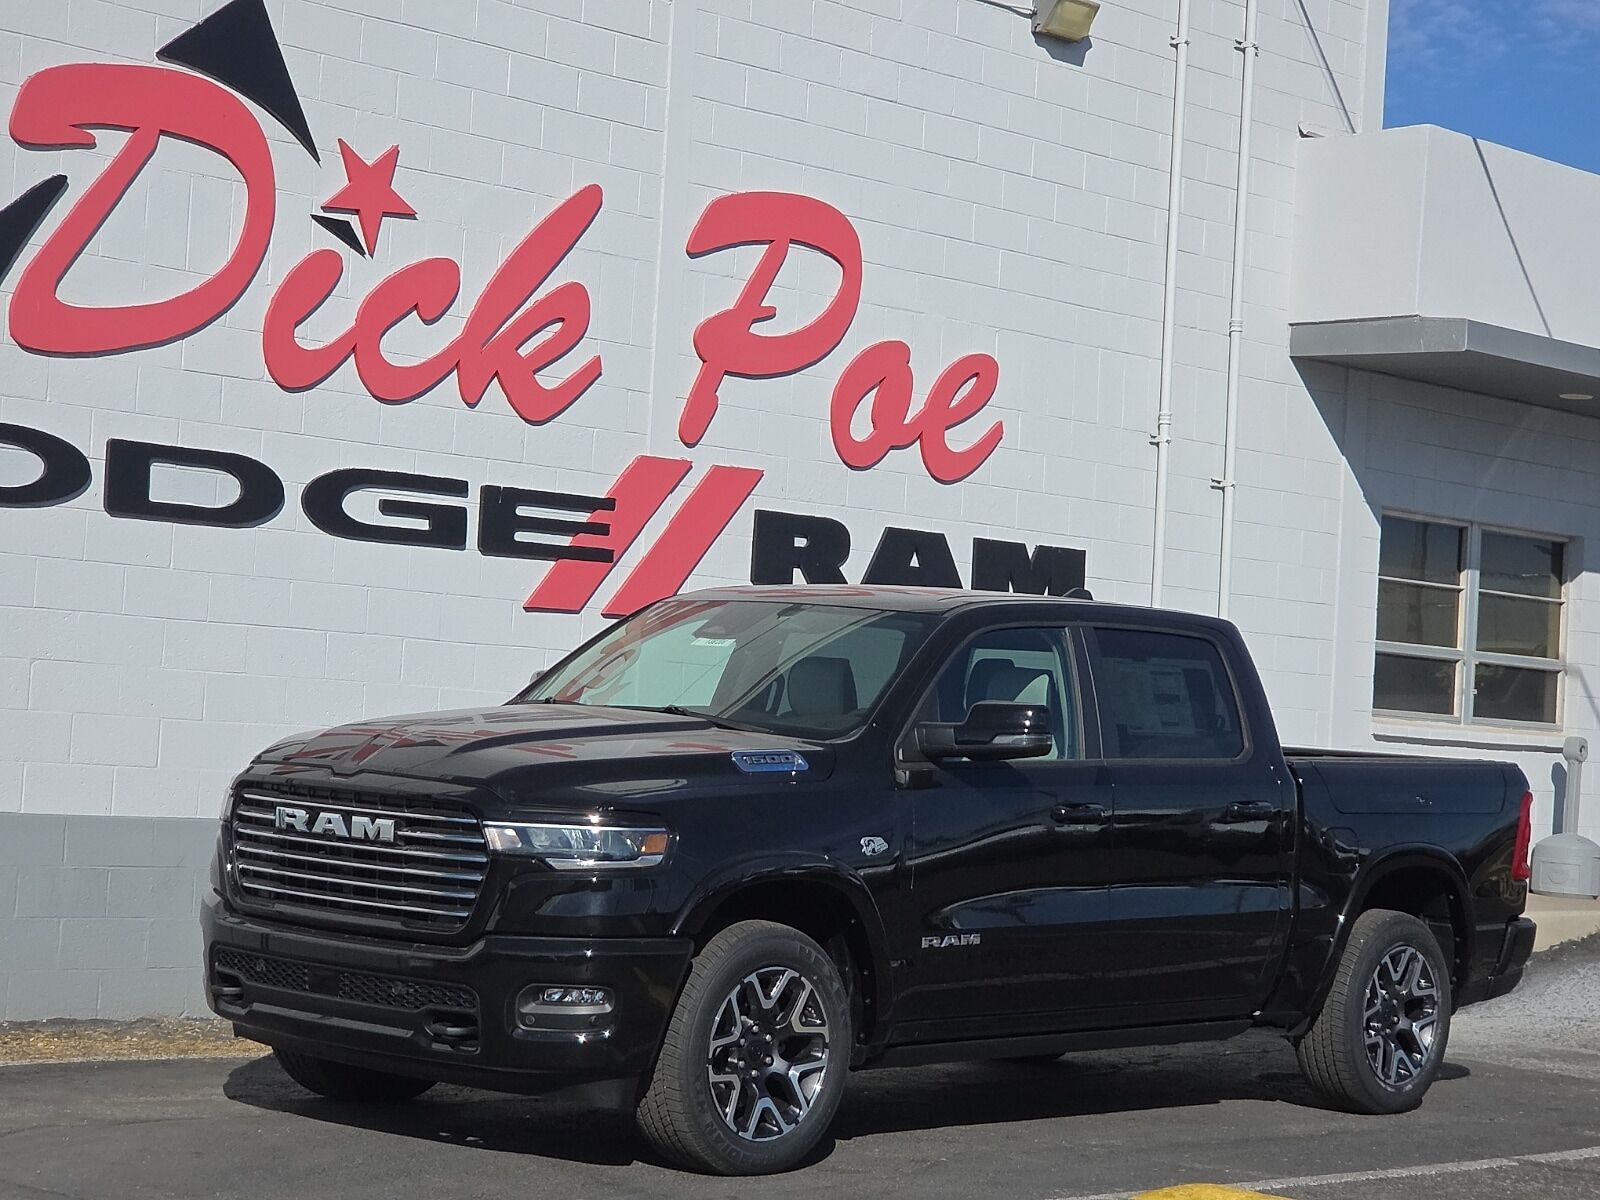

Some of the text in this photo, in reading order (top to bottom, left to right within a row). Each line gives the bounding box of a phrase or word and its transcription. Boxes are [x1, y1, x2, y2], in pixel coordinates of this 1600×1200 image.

[10, 63, 1004, 484] Dick Poe
[751, 509, 1087, 598] RAM
[742, 754, 797, 764] 1500
[275, 806, 395, 842] RAM
[921, 933, 981, 949] RAM
